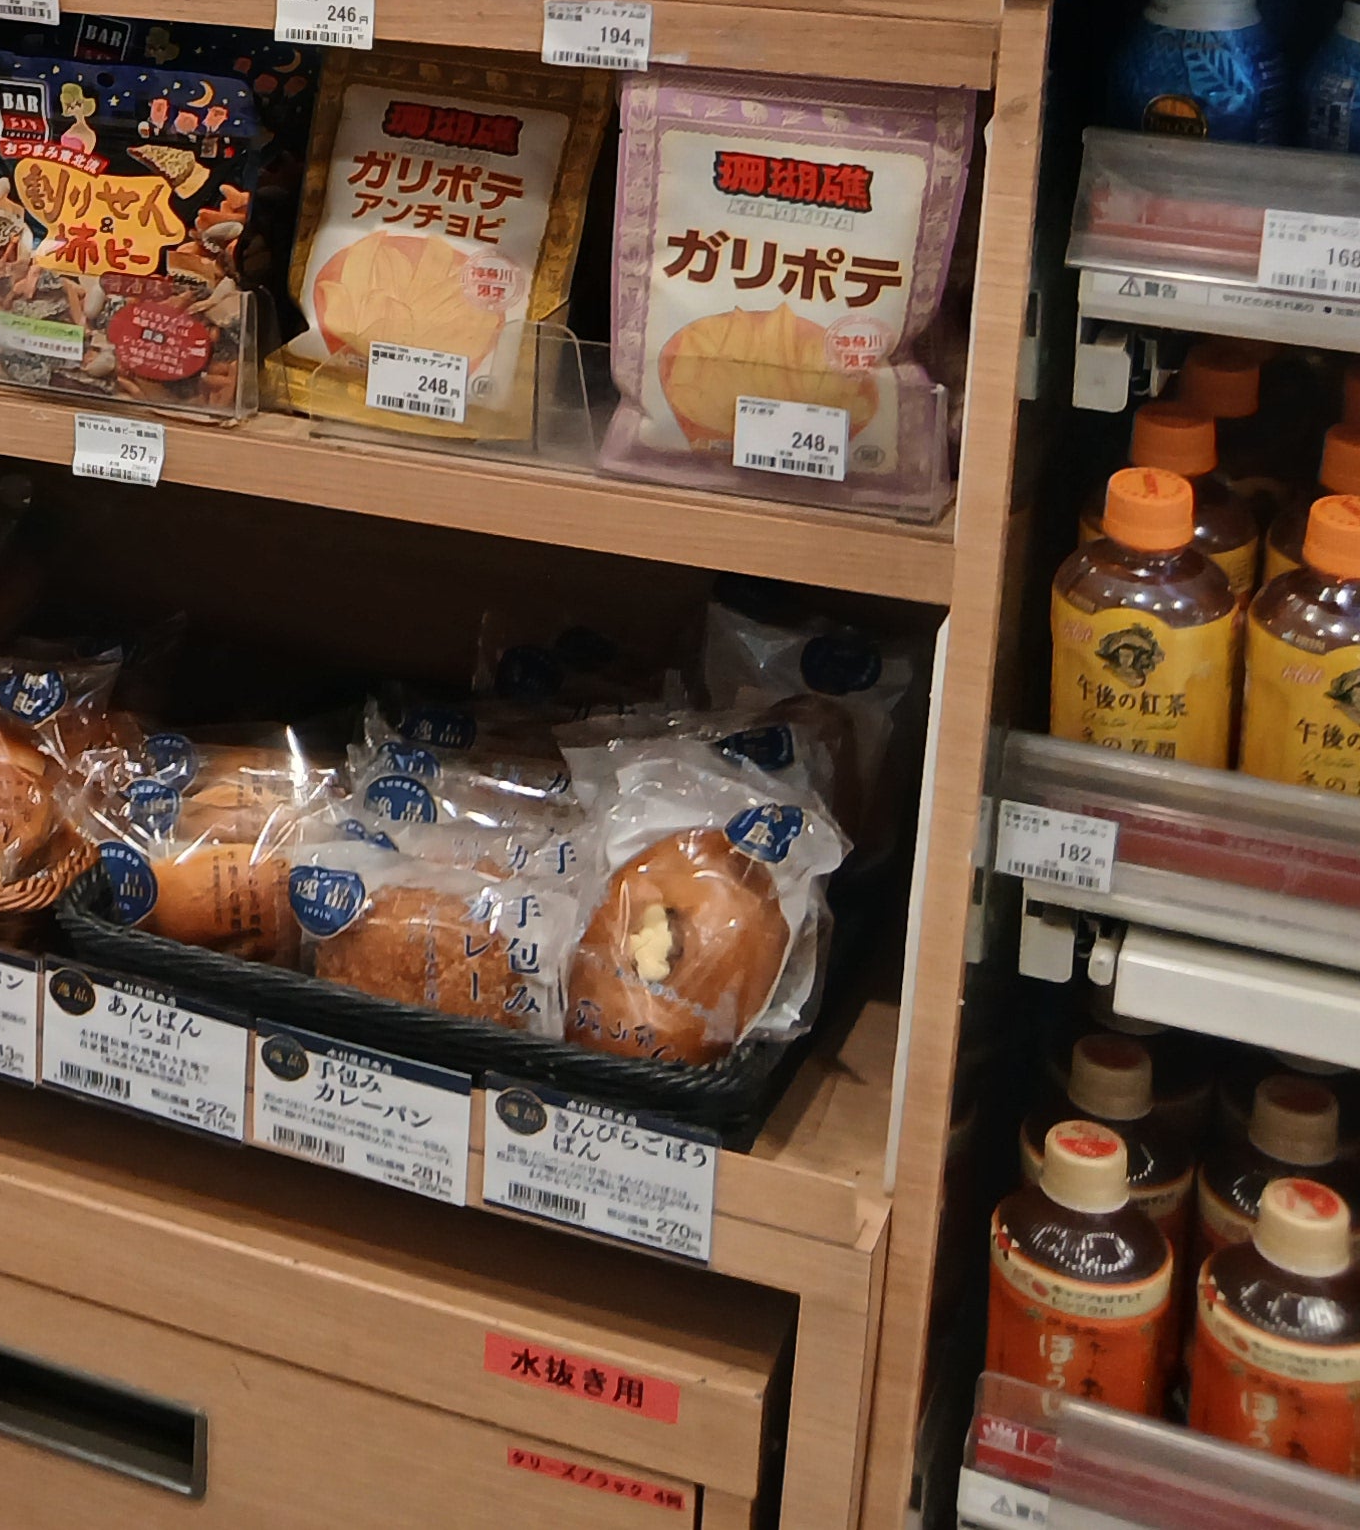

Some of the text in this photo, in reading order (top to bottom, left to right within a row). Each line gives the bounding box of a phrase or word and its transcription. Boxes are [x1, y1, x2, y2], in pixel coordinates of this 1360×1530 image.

[327, 4, 369, 25] 246円
[599, 25, 645, 47] 194円
[2, 93, 39, 113] BAR
[384, 101, 523, 155] 珊瑚礁
[22, 163, 178, 238] 割りせん
[347, 150, 524, 211] ガリポテ
[713, 151, 873, 213] 珊瑚礁
[100, 216, 114, 234] &
[351, 191, 503, 245] アンチョビ
[55, 222, 150, 273] 柿ピー
[663, 228, 903, 308] ガリポテ
[417, 373, 461, 398] 248円
[120, 443, 159, 464] 257円
[790, 430, 840, 456] 248円
[1076, 675, 1188, 718] 午後の紅茶
[1057, 841, 1106, 869] 182円
[509, 894, 542, 1016] 手包み
[195, 1096, 237, 1122] 227円
[314, 1081, 433, 1130] カレーパン
[655, 1217, 703, 1242] 270円
[511, 1348, 644, 1408] 水抜き用
